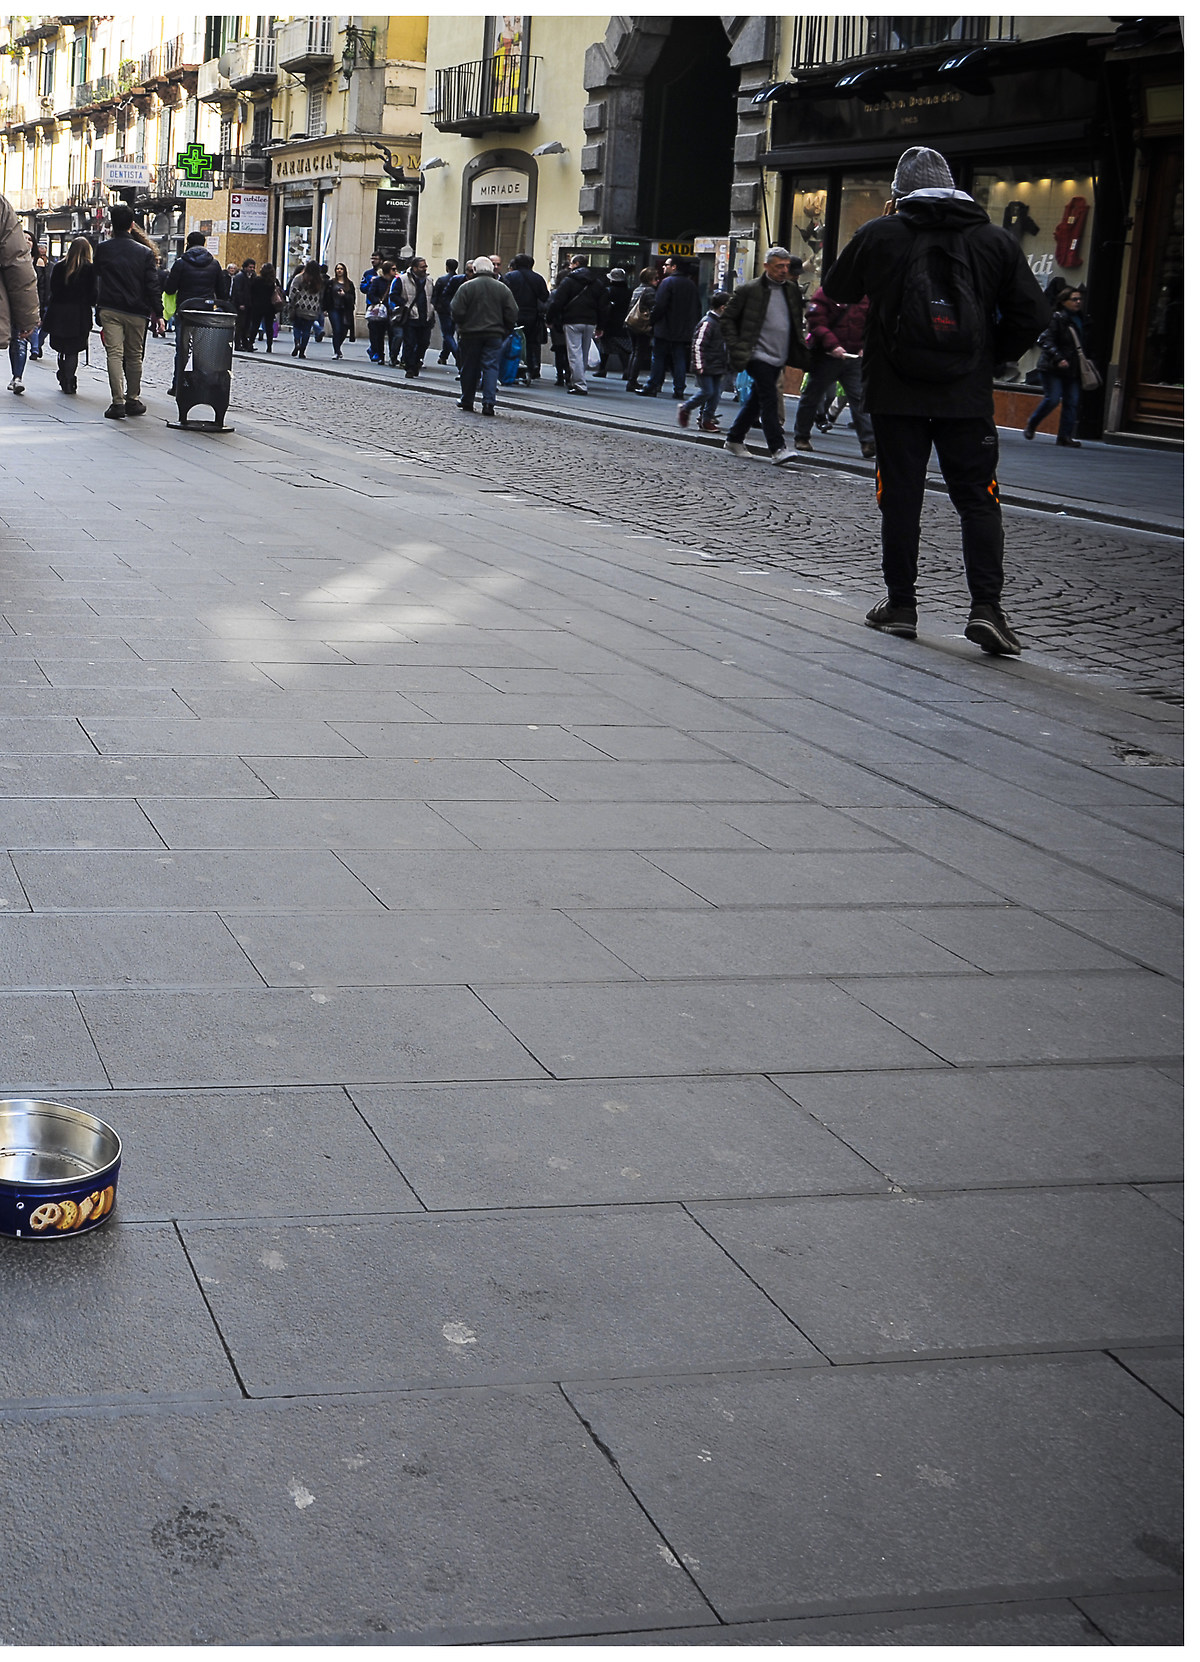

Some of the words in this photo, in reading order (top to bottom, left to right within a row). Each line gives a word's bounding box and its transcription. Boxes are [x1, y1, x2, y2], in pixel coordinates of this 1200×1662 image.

[277, 154, 333, 177] FARMACIA
[109, 170, 143, 179] DENTISTA
[180, 181, 210, 189] FARMACIA
[480, 183, 520, 195] MIRIADE
[179, 189, 209, 197] PHARMACY
[660, 243, 694, 256] SALDI
[1027, 254, 1054, 275] ldi
